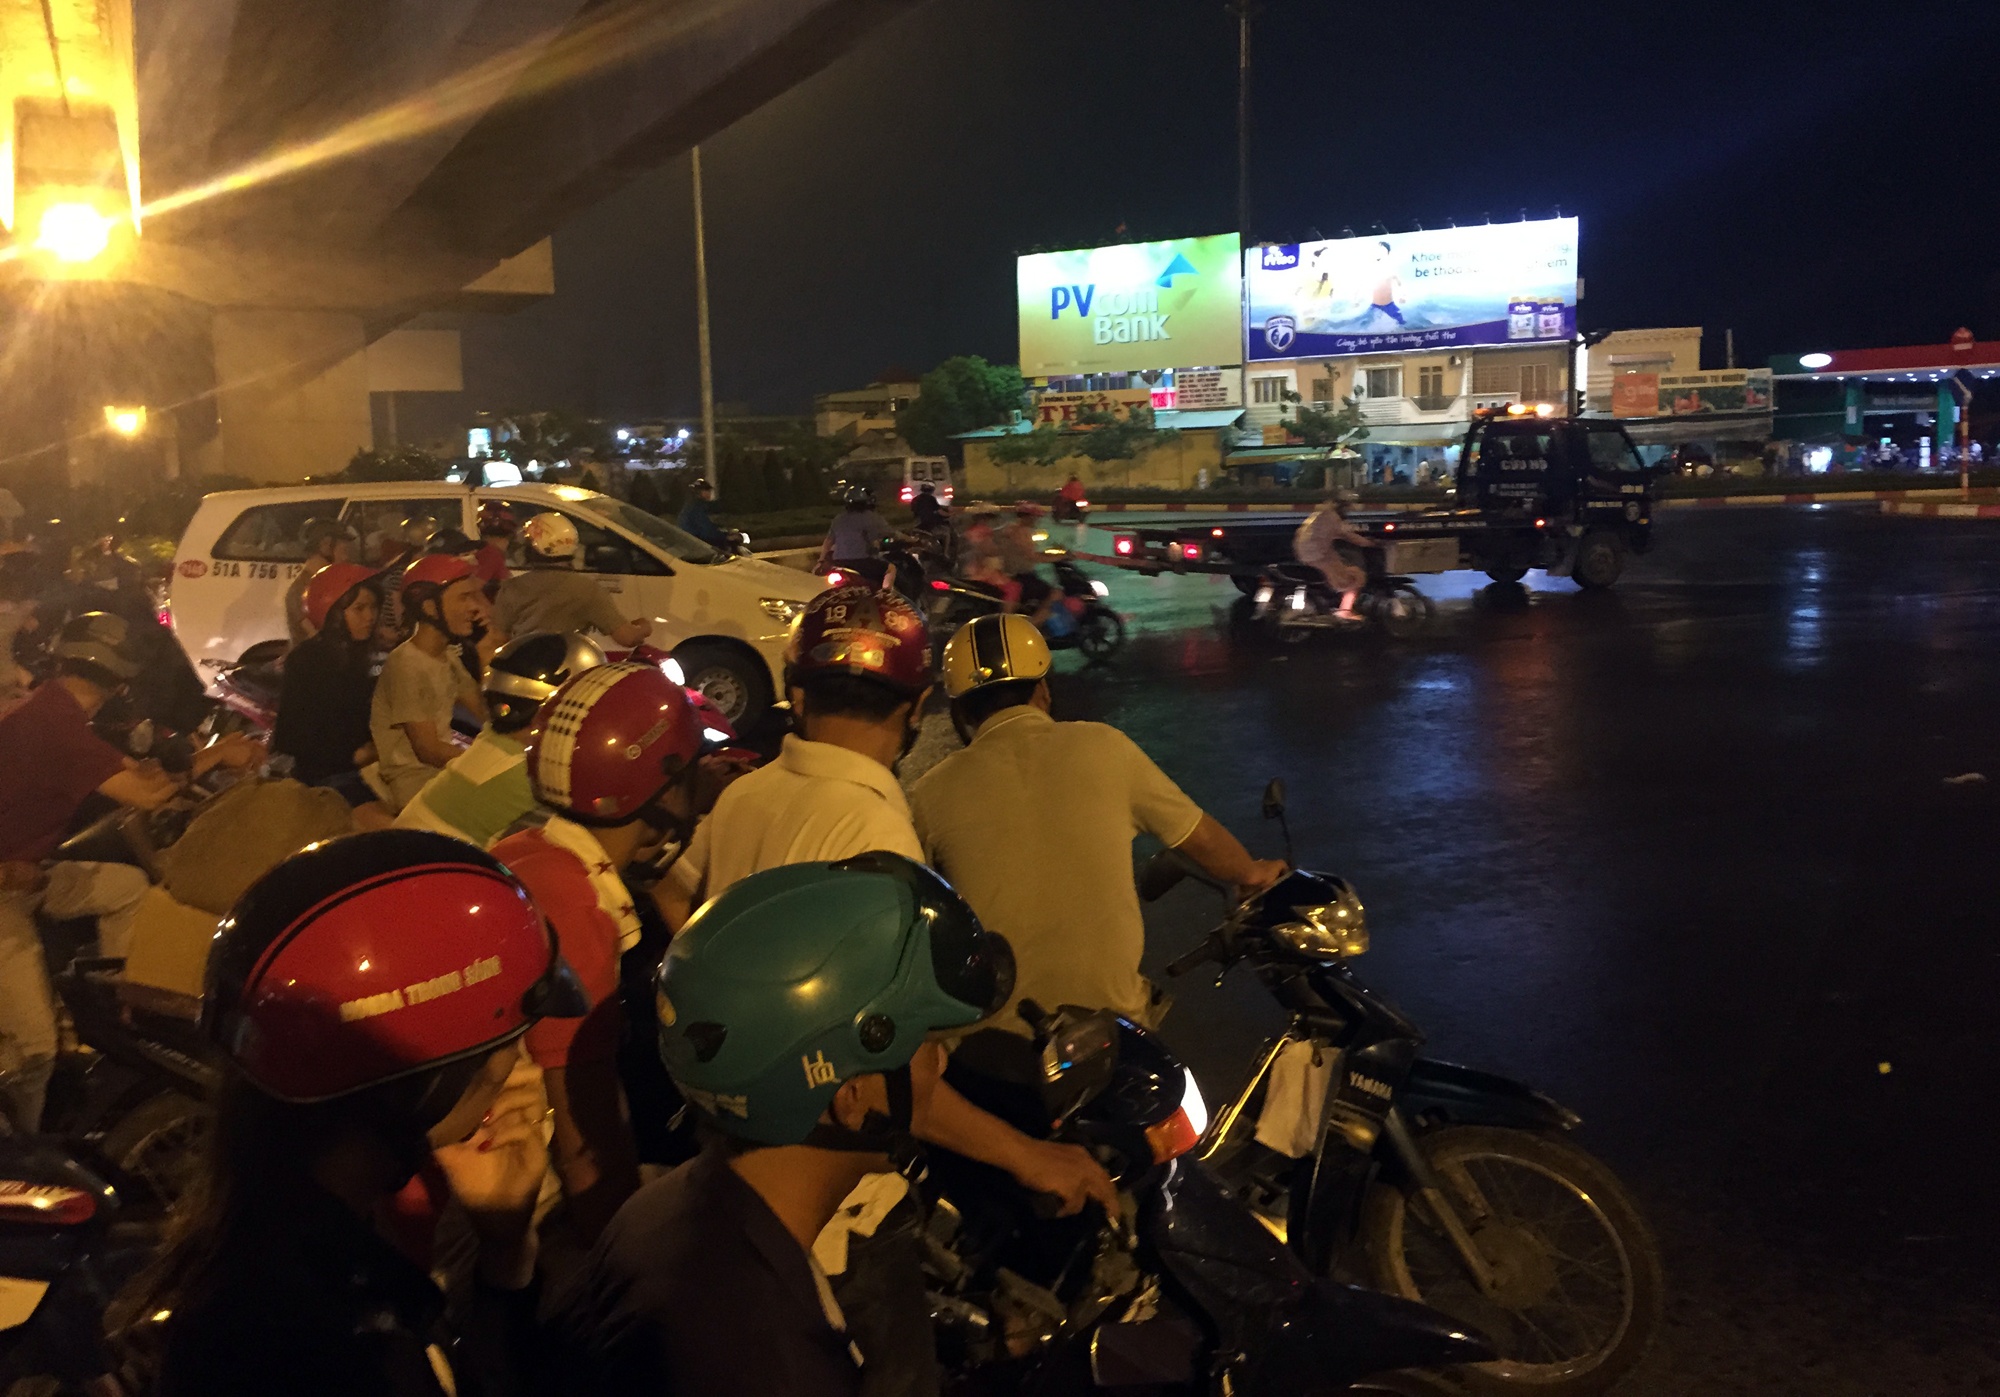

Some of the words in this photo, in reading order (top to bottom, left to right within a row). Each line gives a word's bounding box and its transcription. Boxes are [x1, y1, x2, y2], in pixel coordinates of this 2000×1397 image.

[1093, 313, 1172, 346] Bank
[212, 561, 241, 577] 51A
[1350, 1070, 1393, 1101] YAMAHA
